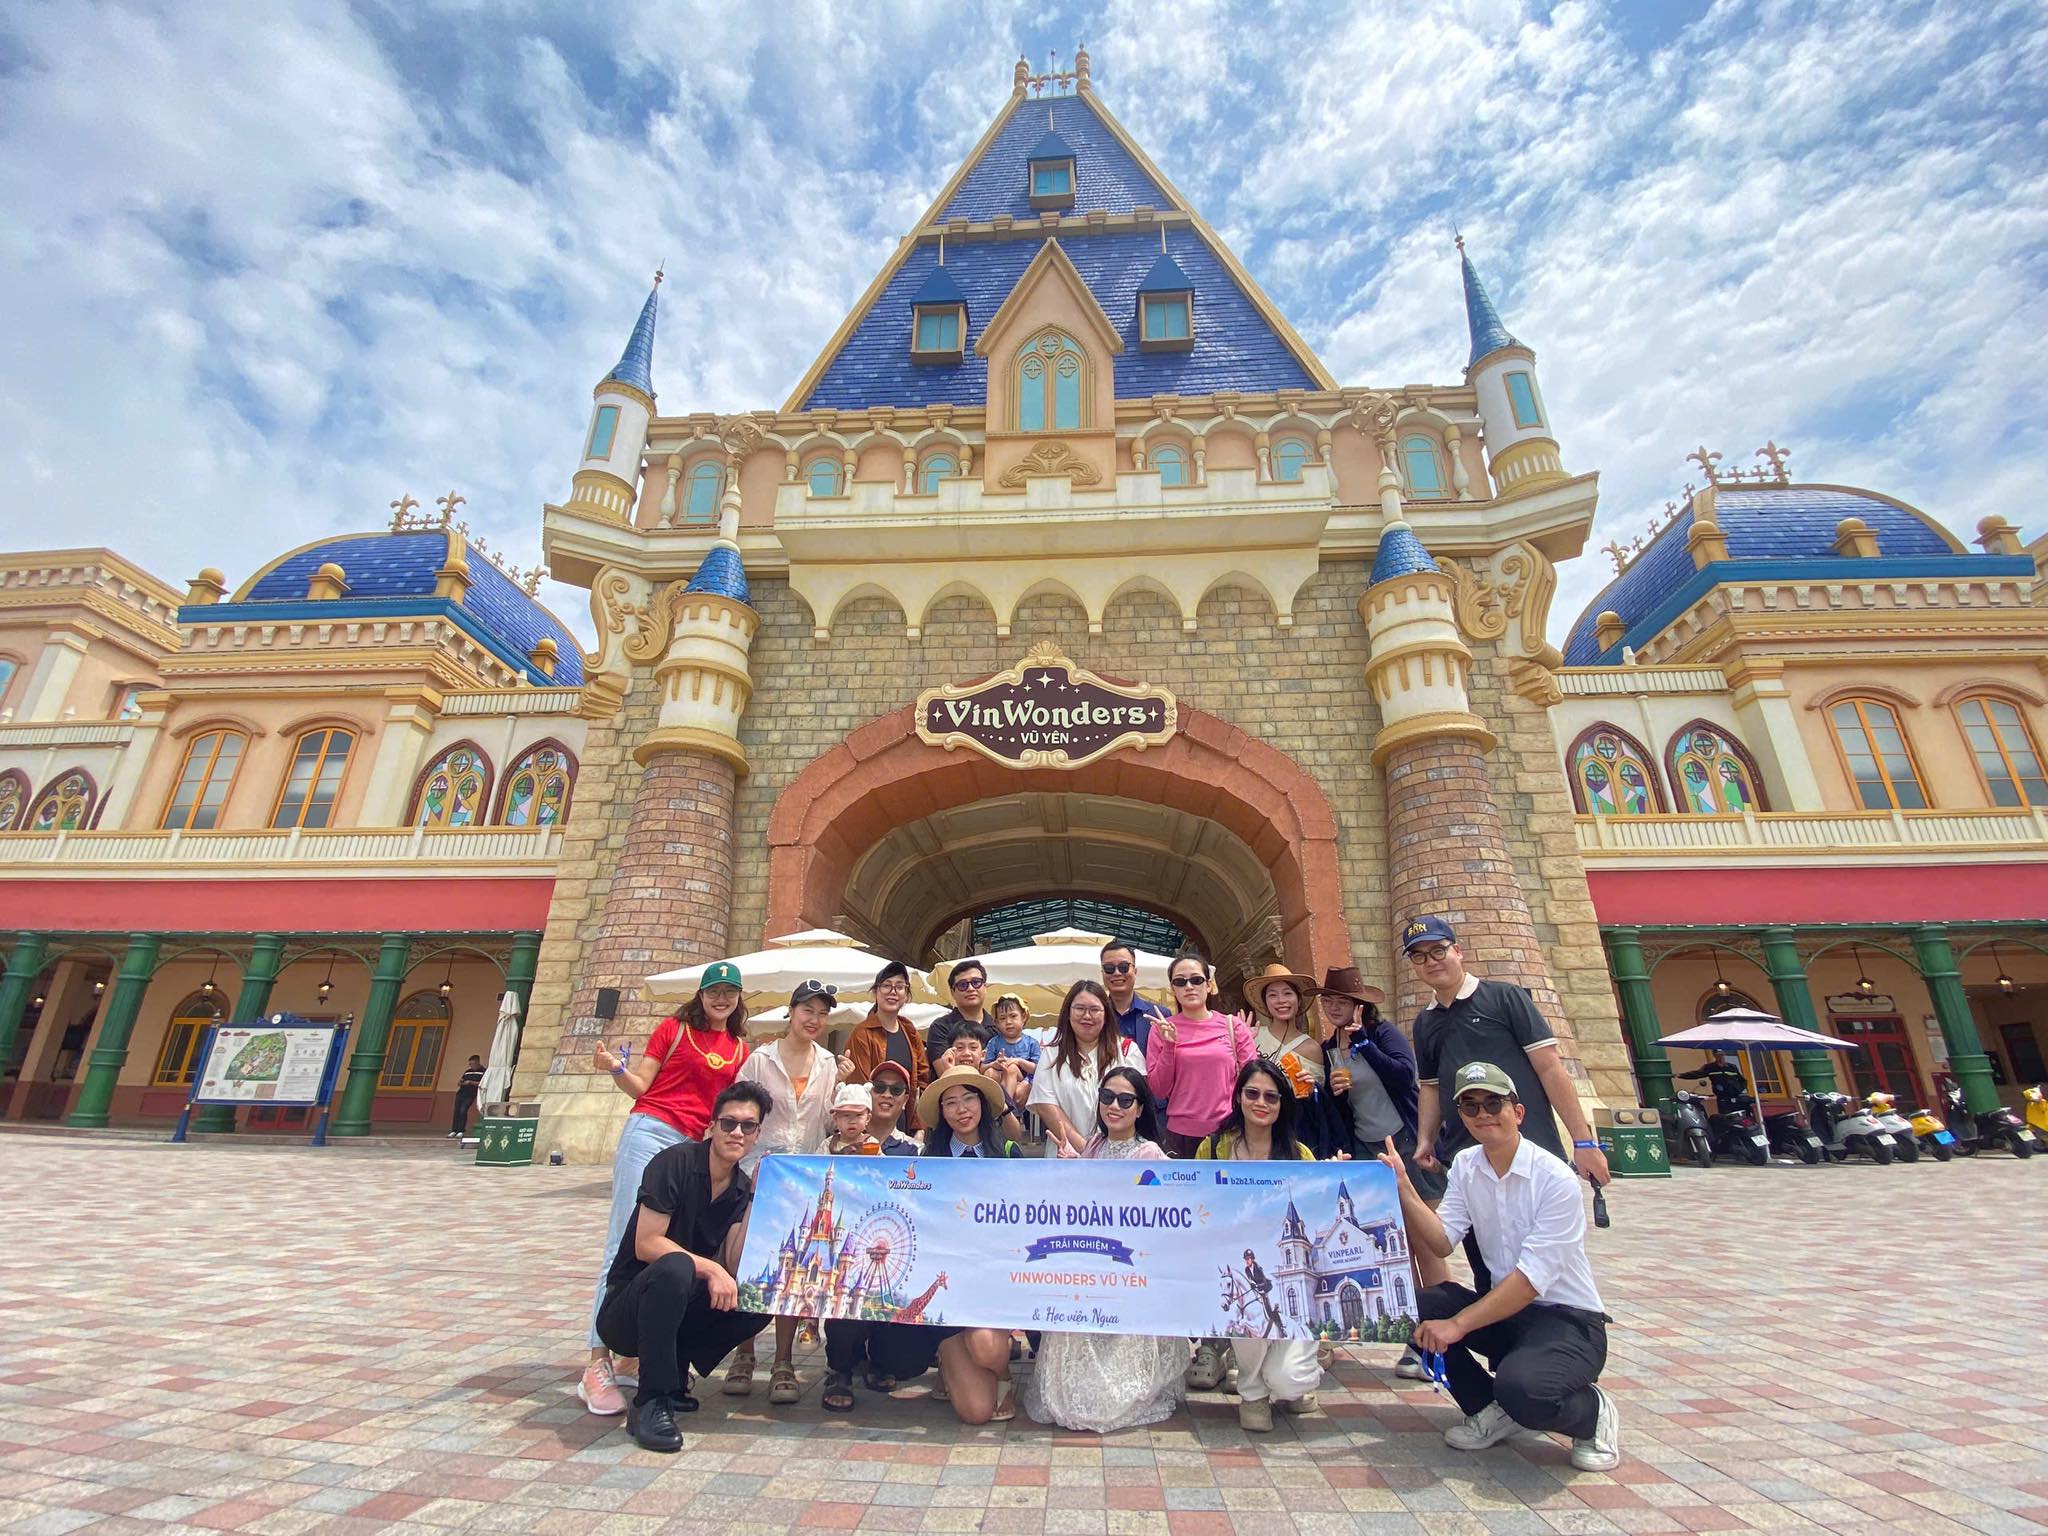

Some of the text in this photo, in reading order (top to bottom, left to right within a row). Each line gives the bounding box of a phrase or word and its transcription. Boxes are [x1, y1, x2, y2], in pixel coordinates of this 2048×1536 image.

[944, 700, 1147, 728] VinWonders
[1020, 729, 1070, 744] VŨ YÊN
[888, 1179, 932, 1190] VinWonders
[974, 1199, 1193, 1229] CHÀO ĐÓN ĐOÀN KOL/KOC
[1050, 1238, 1109, 1252] TRẢI NGHIỆM
[1328, 1245, 1364, 1259] VINPEARL
[1010, 1271, 1147, 1288] VINWONDERS VŨ YÊN
[1032, 1308, 1041, 1321] &
[1045, 1306, 1065, 1325] Học
[1067, 1309, 1089, 1325] viện
